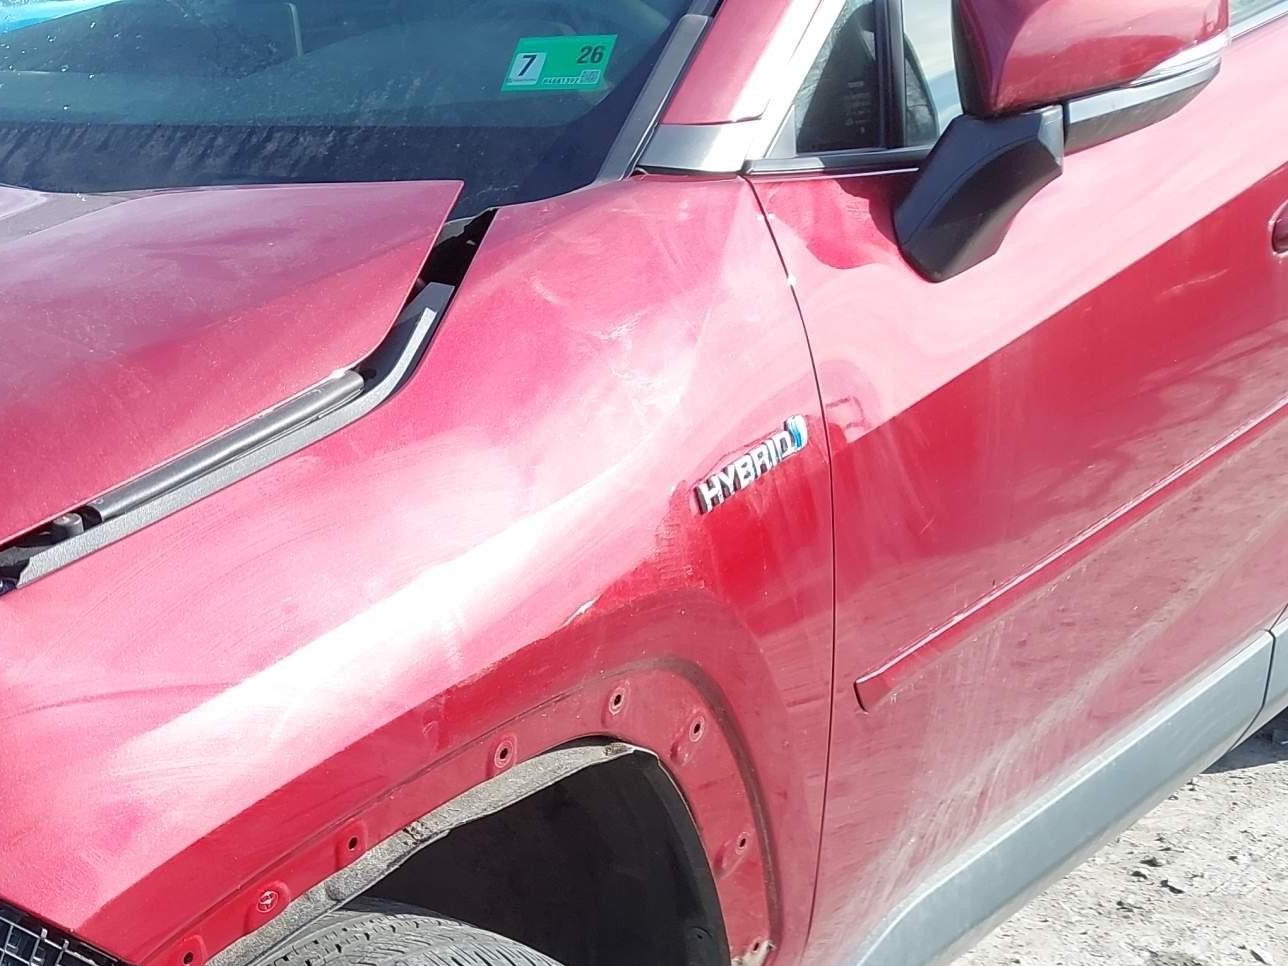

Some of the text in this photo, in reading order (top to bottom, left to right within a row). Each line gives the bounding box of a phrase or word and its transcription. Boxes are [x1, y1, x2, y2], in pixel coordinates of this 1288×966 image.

[518, 54, 537, 77] 7
[577, 45, 605, 64] 26
[695, 430, 795, 514] HYBRID
